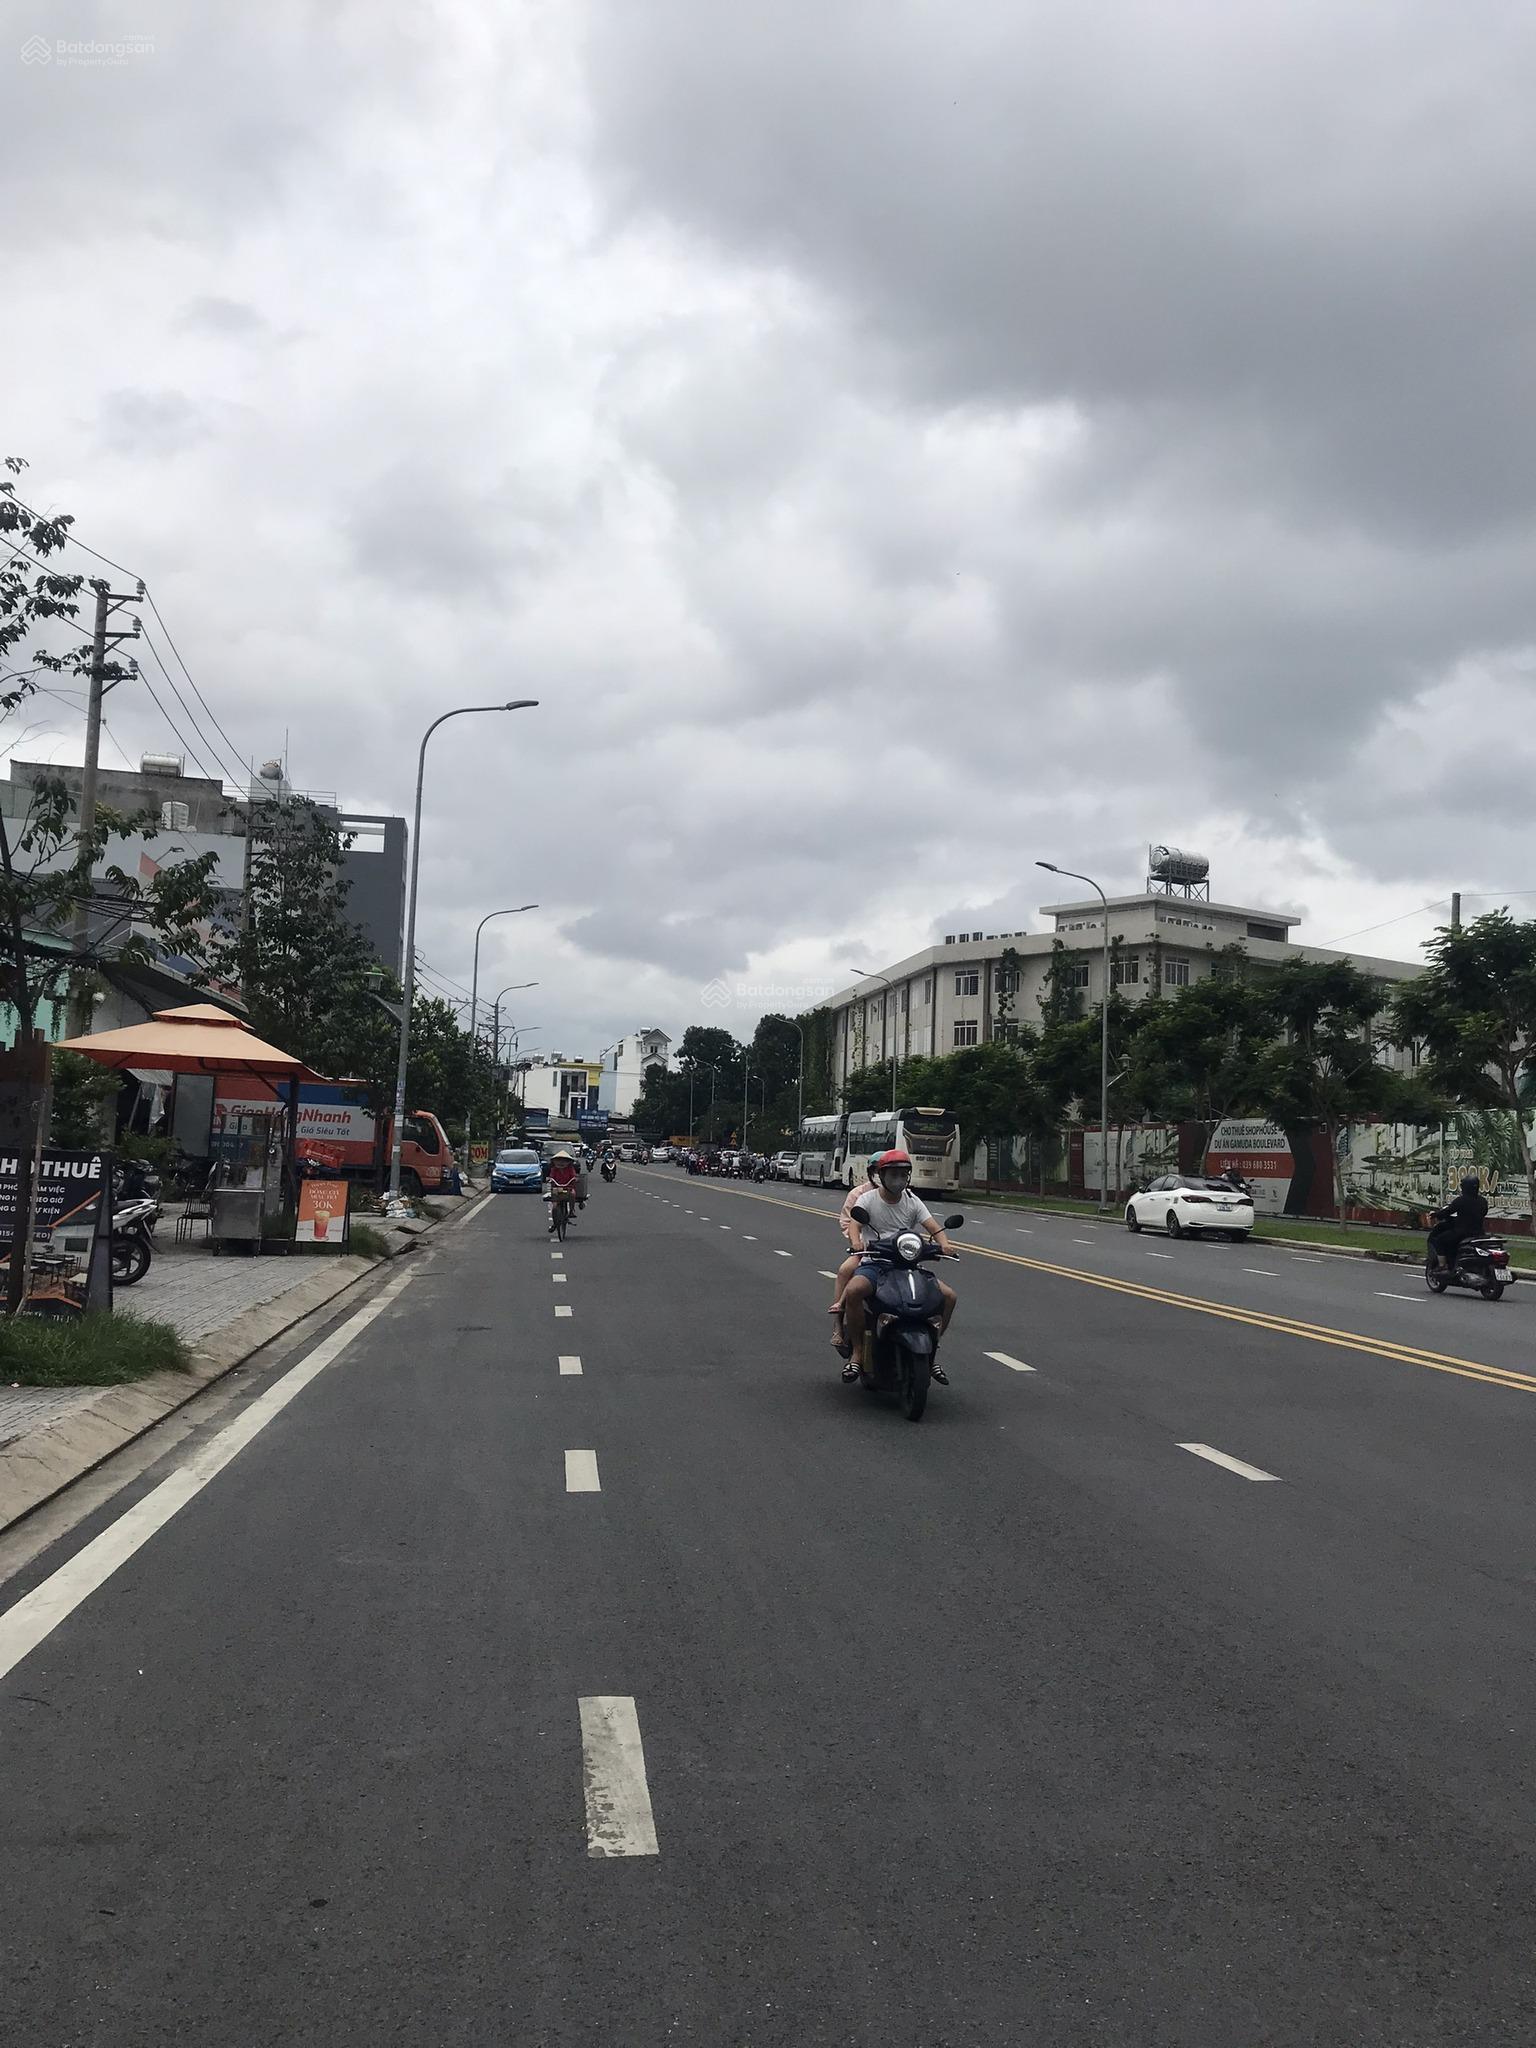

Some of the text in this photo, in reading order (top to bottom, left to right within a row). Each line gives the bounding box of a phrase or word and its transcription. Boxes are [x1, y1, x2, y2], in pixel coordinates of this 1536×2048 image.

[1221, 1126, 1232, 1136] CHO
[1245, 1125, 1278, 1136] SHOPHOUSE
[1253, 1138, 1286, 1149] BOULEVARD
[41, 1156, 101, 1179] THUÊ
[313, 1201, 333, 1210] 30K
